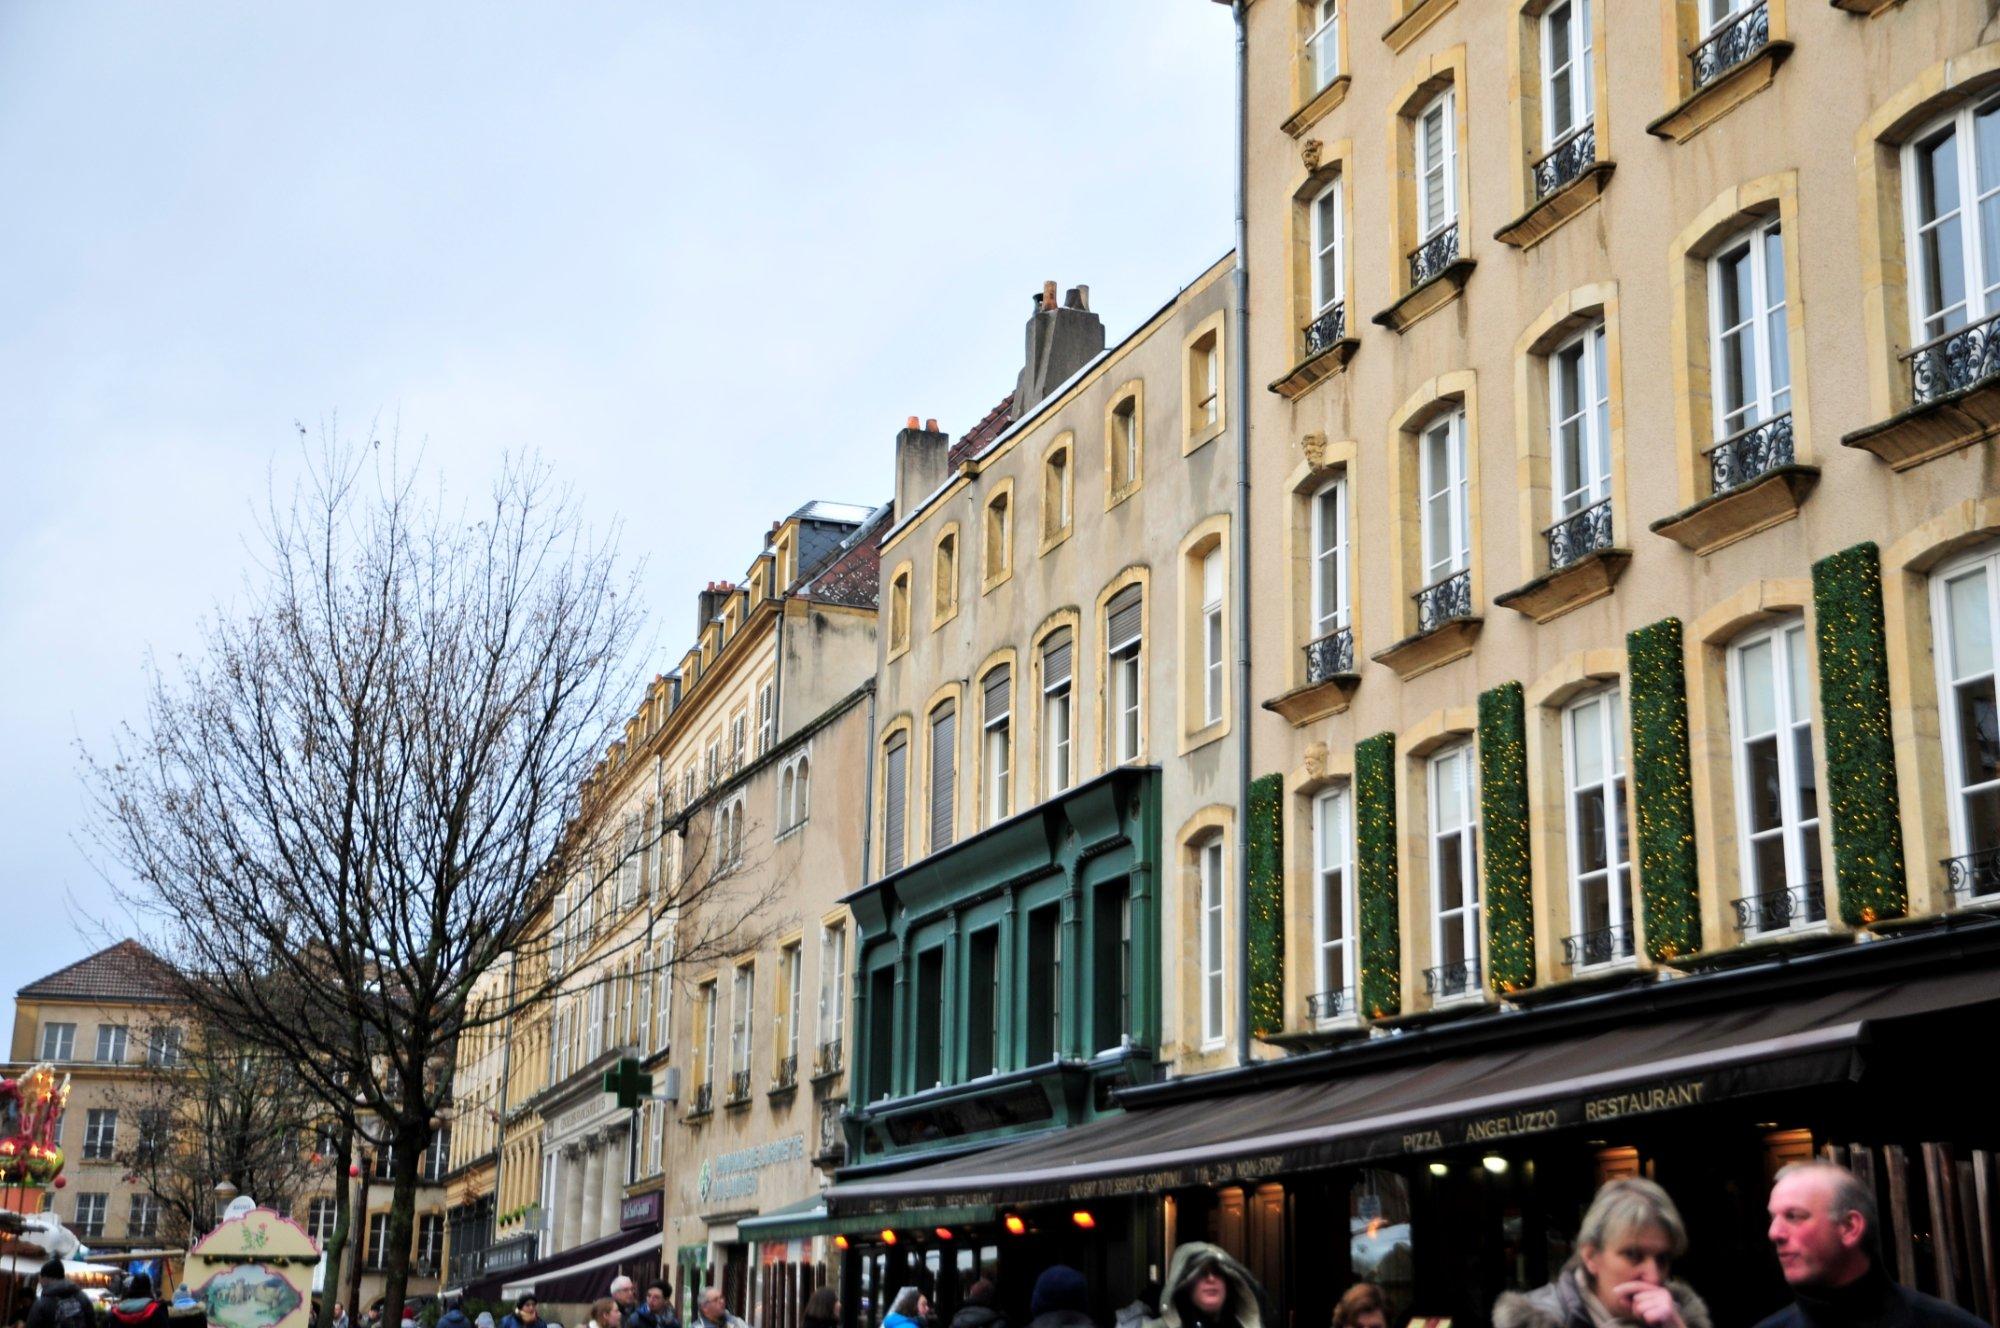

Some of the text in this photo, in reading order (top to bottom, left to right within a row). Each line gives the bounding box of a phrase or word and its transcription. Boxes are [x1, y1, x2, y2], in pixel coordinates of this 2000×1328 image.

[1403, 1130, 1442, 1152] PIZZA
[1585, 1081, 1704, 1121] RESTAURANT
[1115, 1174, 1145, 1194] SERVICE
[1146, 1170, 1182, 1192] CONTINU
[1236, 1155, 1283, 1178] NON-STOP
